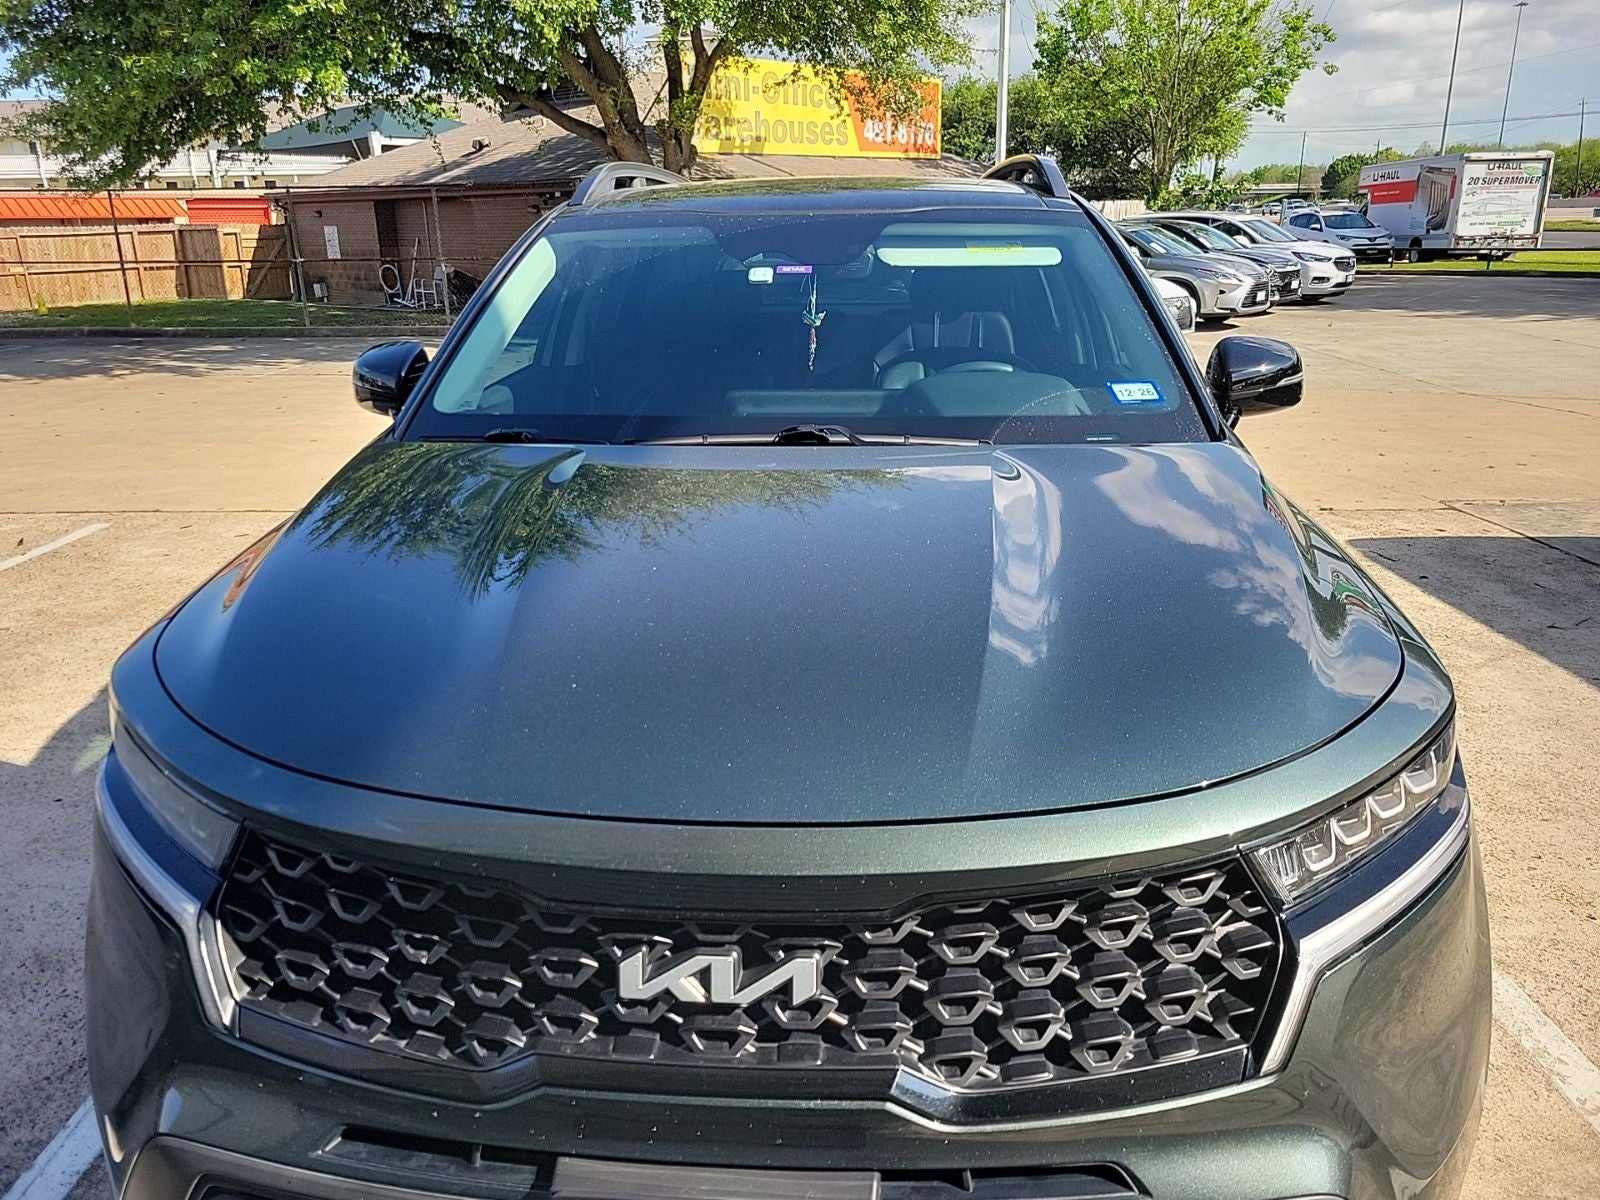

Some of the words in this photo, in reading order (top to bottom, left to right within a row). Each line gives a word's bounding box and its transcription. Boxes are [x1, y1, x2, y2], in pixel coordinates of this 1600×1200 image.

[703, 110, 849, 146] arehouses
[1481, 175, 1541, 185] SUPERMOVER
[619, 950, 818, 1007] KIA
